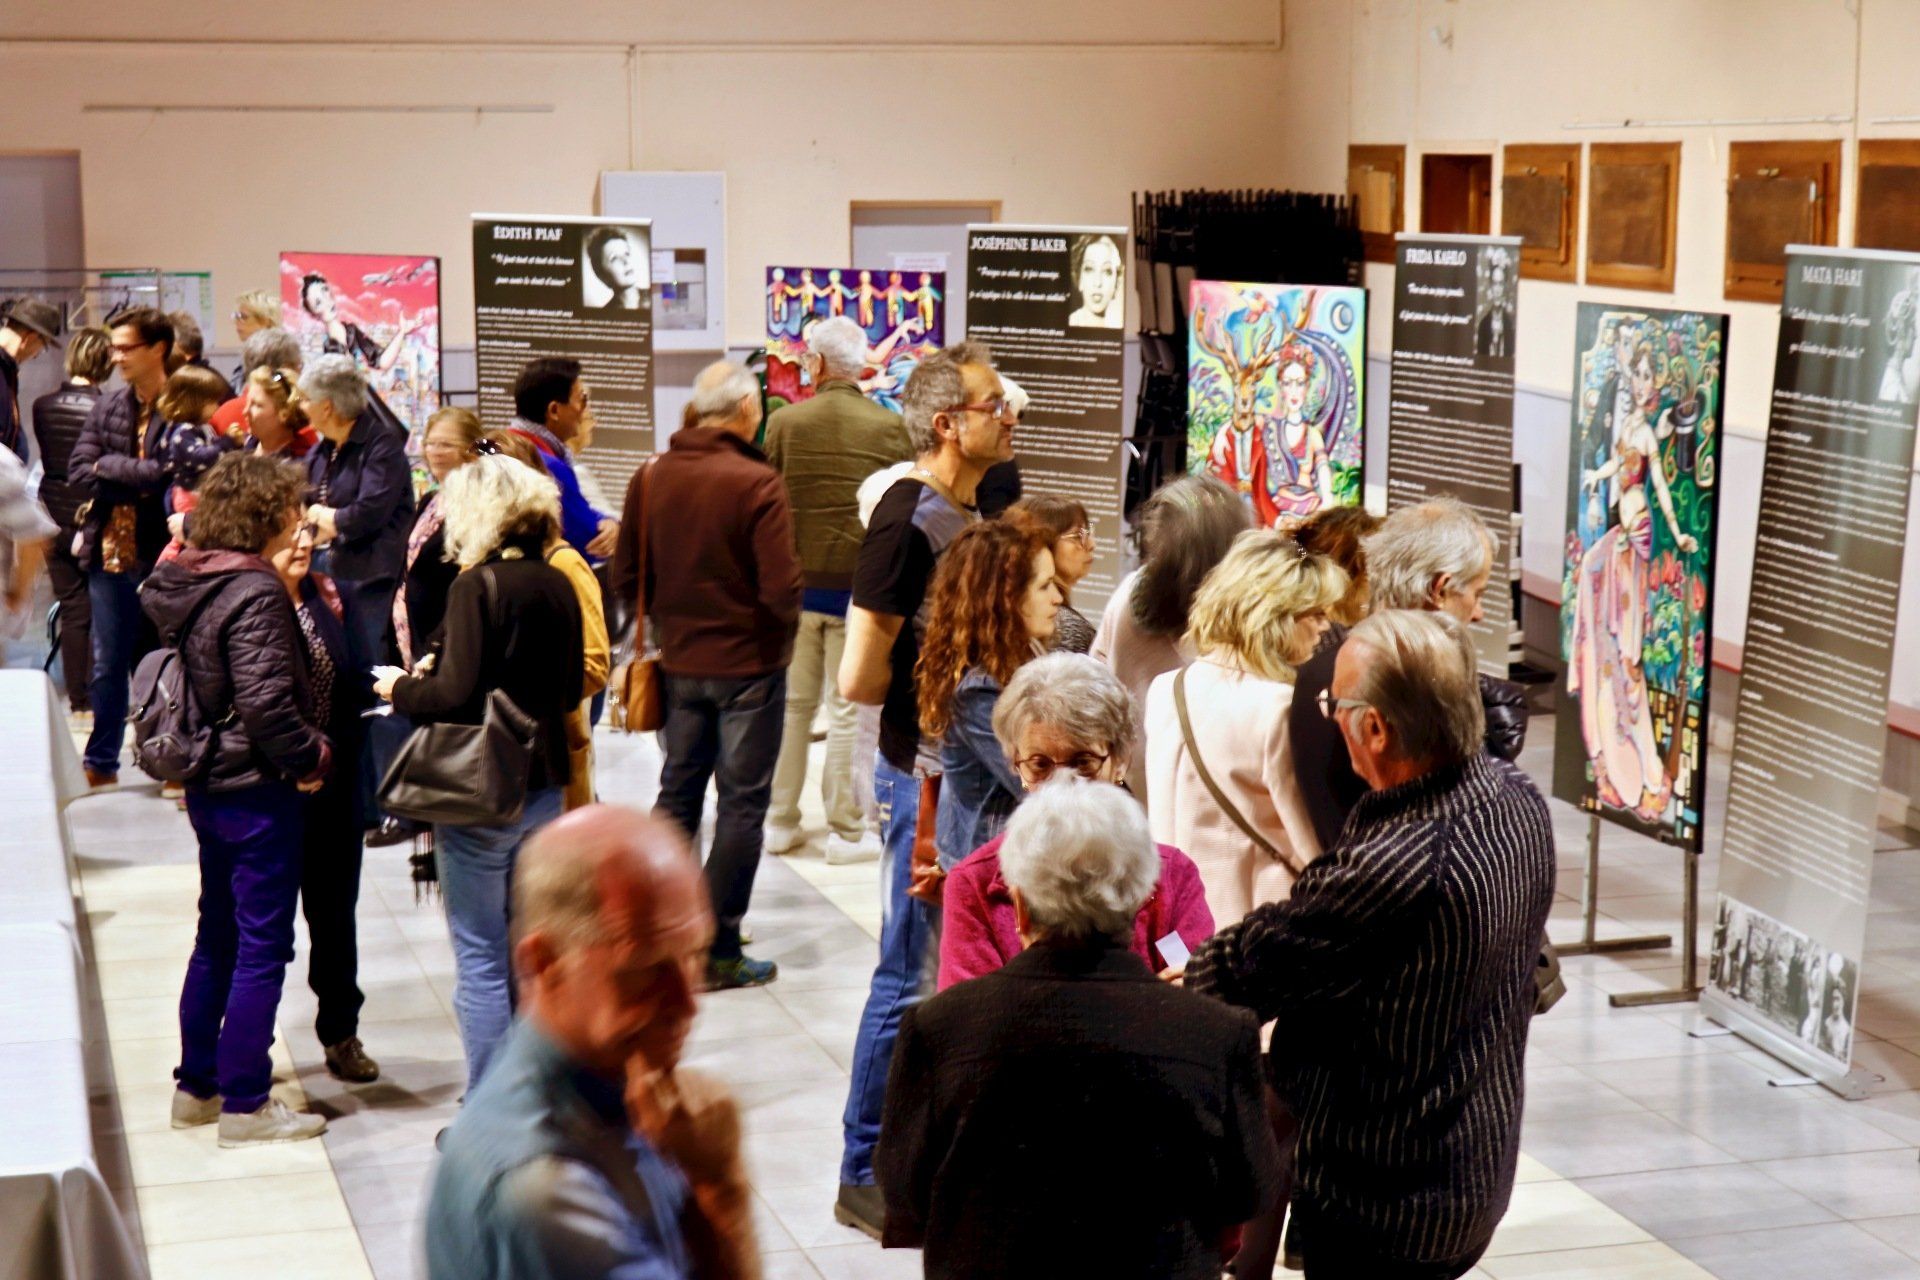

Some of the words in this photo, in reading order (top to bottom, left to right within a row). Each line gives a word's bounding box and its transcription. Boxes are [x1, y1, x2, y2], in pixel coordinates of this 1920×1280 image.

[535, 227, 563, 241] PIAF
[1031, 237, 1067, 252] BAKER
[1405, 248, 1433, 265] FRIDA
[1434, 249, 1467, 266] KAHLO
[1801, 265, 1832, 285] MATA
[1834, 268, 1863, 287] HARI
